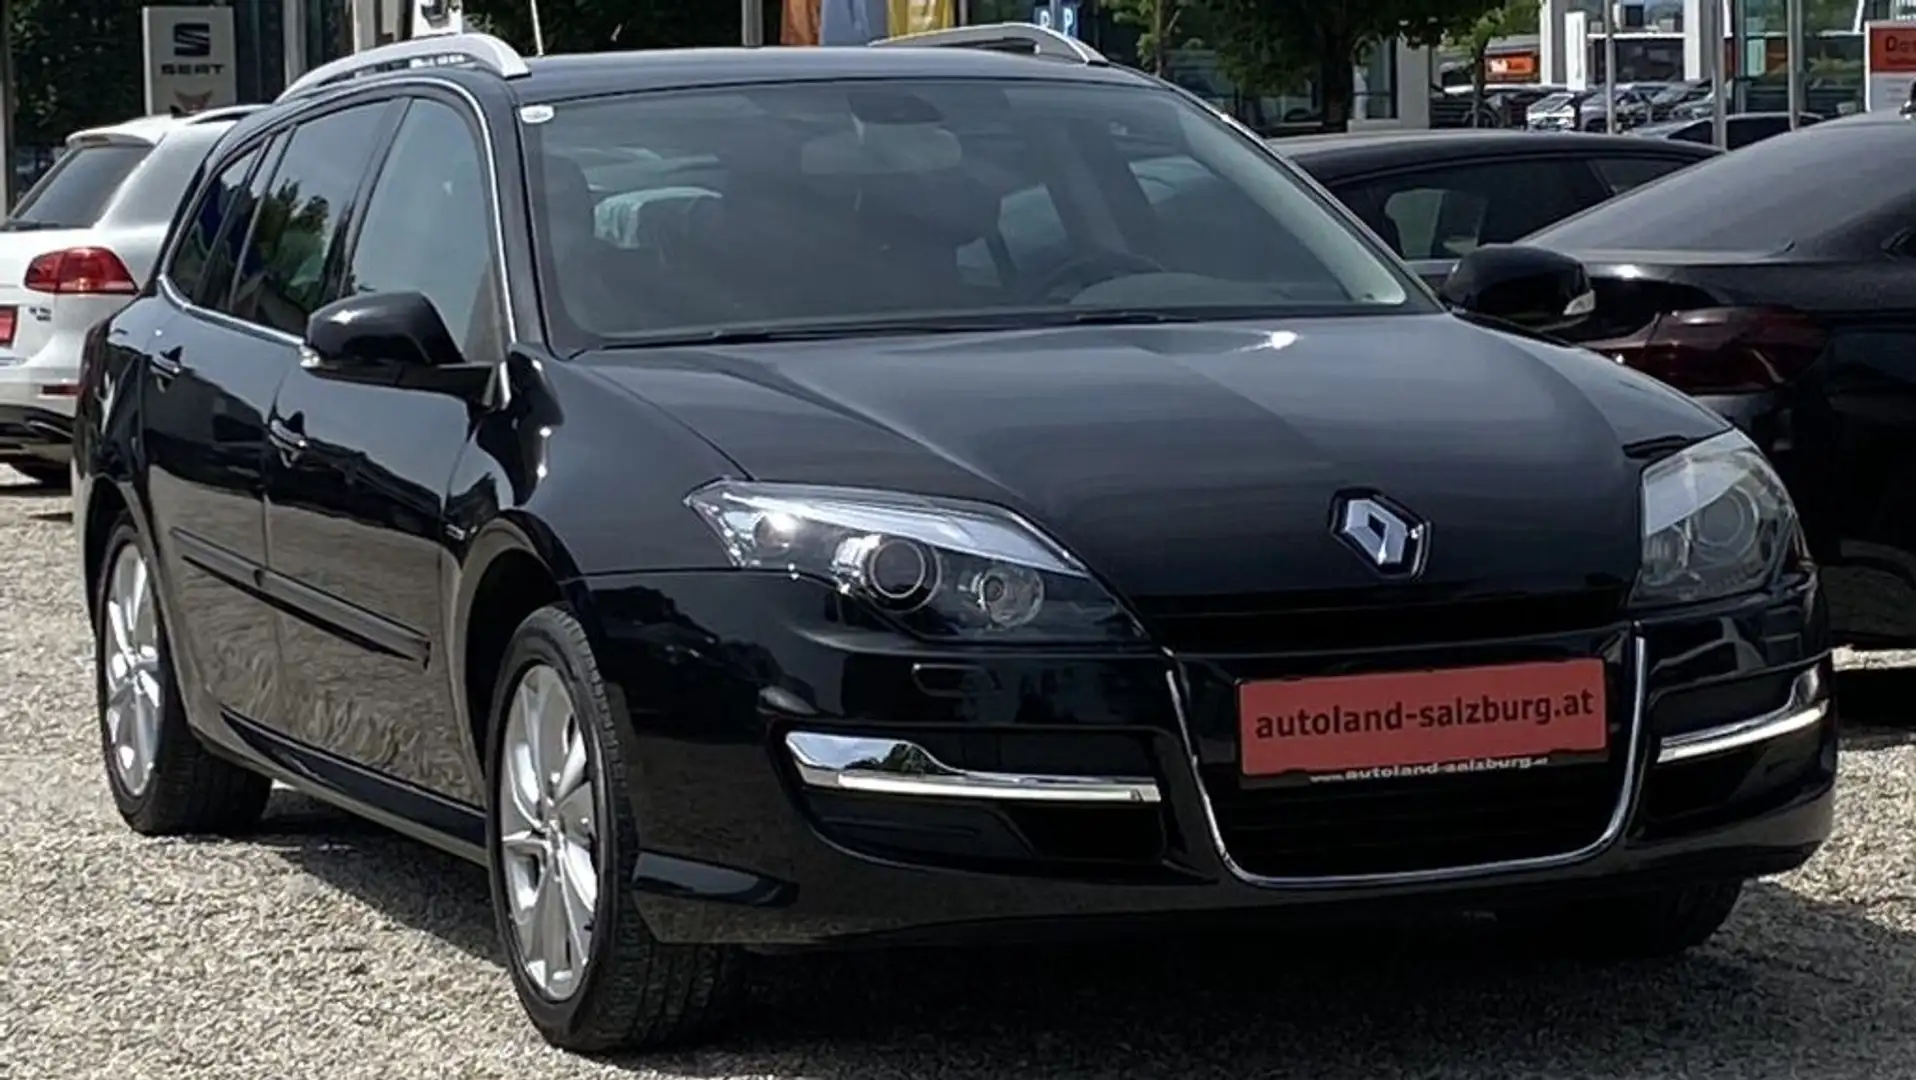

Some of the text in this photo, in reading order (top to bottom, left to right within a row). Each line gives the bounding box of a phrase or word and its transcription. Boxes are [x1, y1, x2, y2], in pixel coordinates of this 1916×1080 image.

[1063, 7, 1074, 38] P
[161, 63, 225, 76] SEAT
[1255, 687, 1595, 740] autoland-salzburg.at
